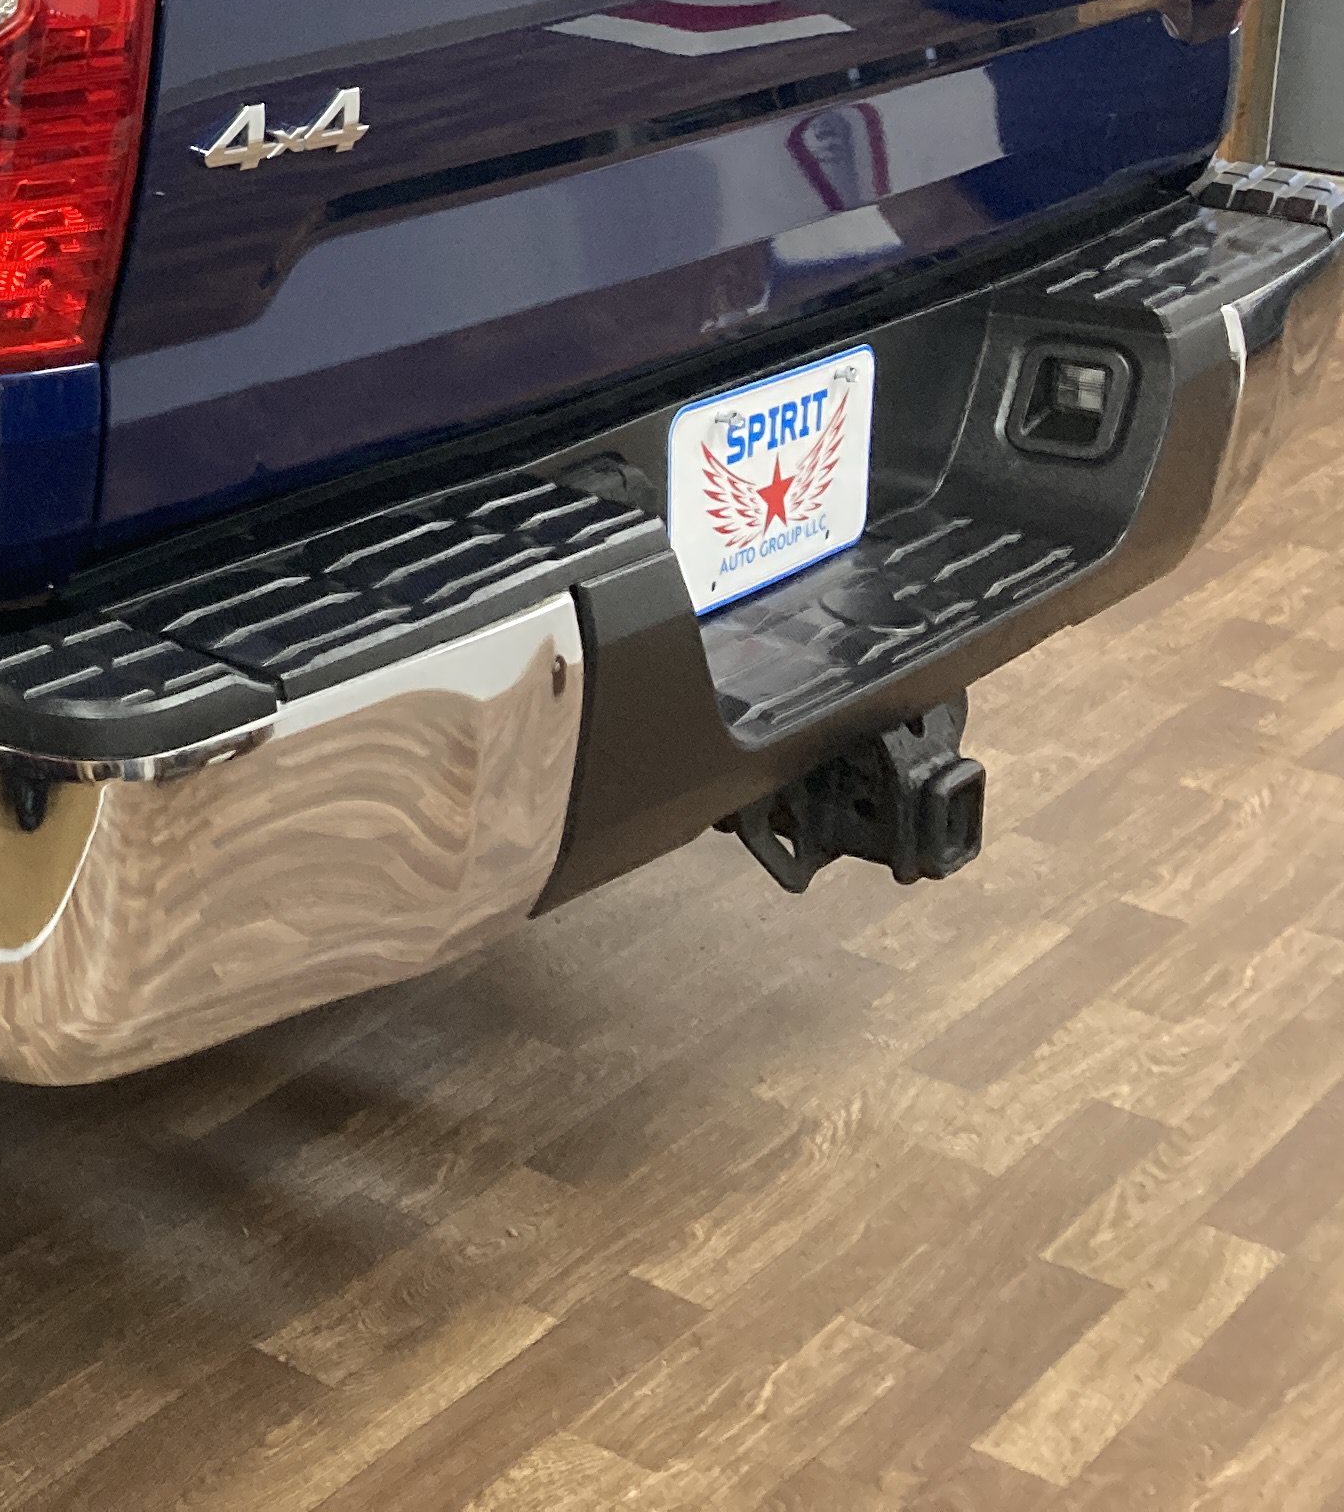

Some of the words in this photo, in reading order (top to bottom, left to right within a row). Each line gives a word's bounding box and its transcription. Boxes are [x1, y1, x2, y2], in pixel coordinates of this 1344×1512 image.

[726, 389, 828, 466] SPIRIT
[719, 546, 756, 575] AUTO
[761, 526, 803, 559] GROUP
[803, 514, 828, 537] LLC
